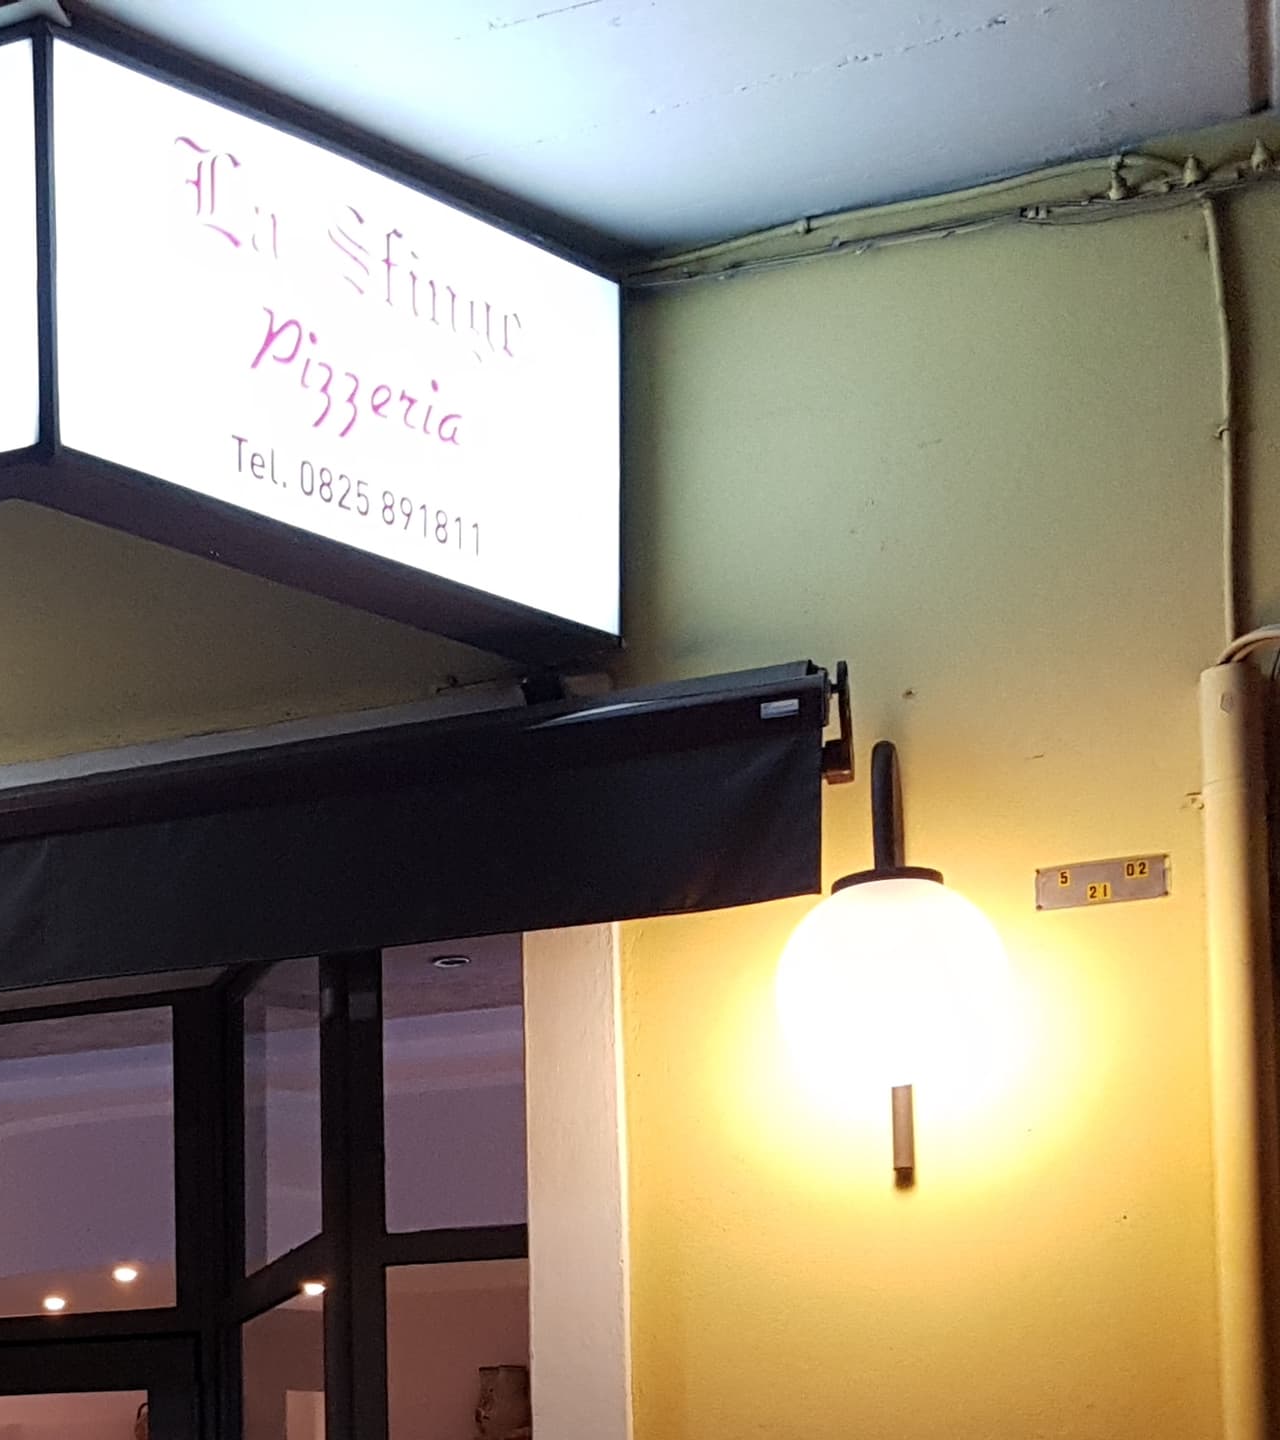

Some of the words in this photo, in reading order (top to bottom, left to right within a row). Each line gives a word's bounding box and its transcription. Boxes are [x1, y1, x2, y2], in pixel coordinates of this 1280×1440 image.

[173, 135, 279, 260] La
[249, 306, 462, 446] Pizzeria
[231, 434, 287, 488] Tel.
[300, 460, 370, 517] 0825
[381, 490, 479, 556] 891811
